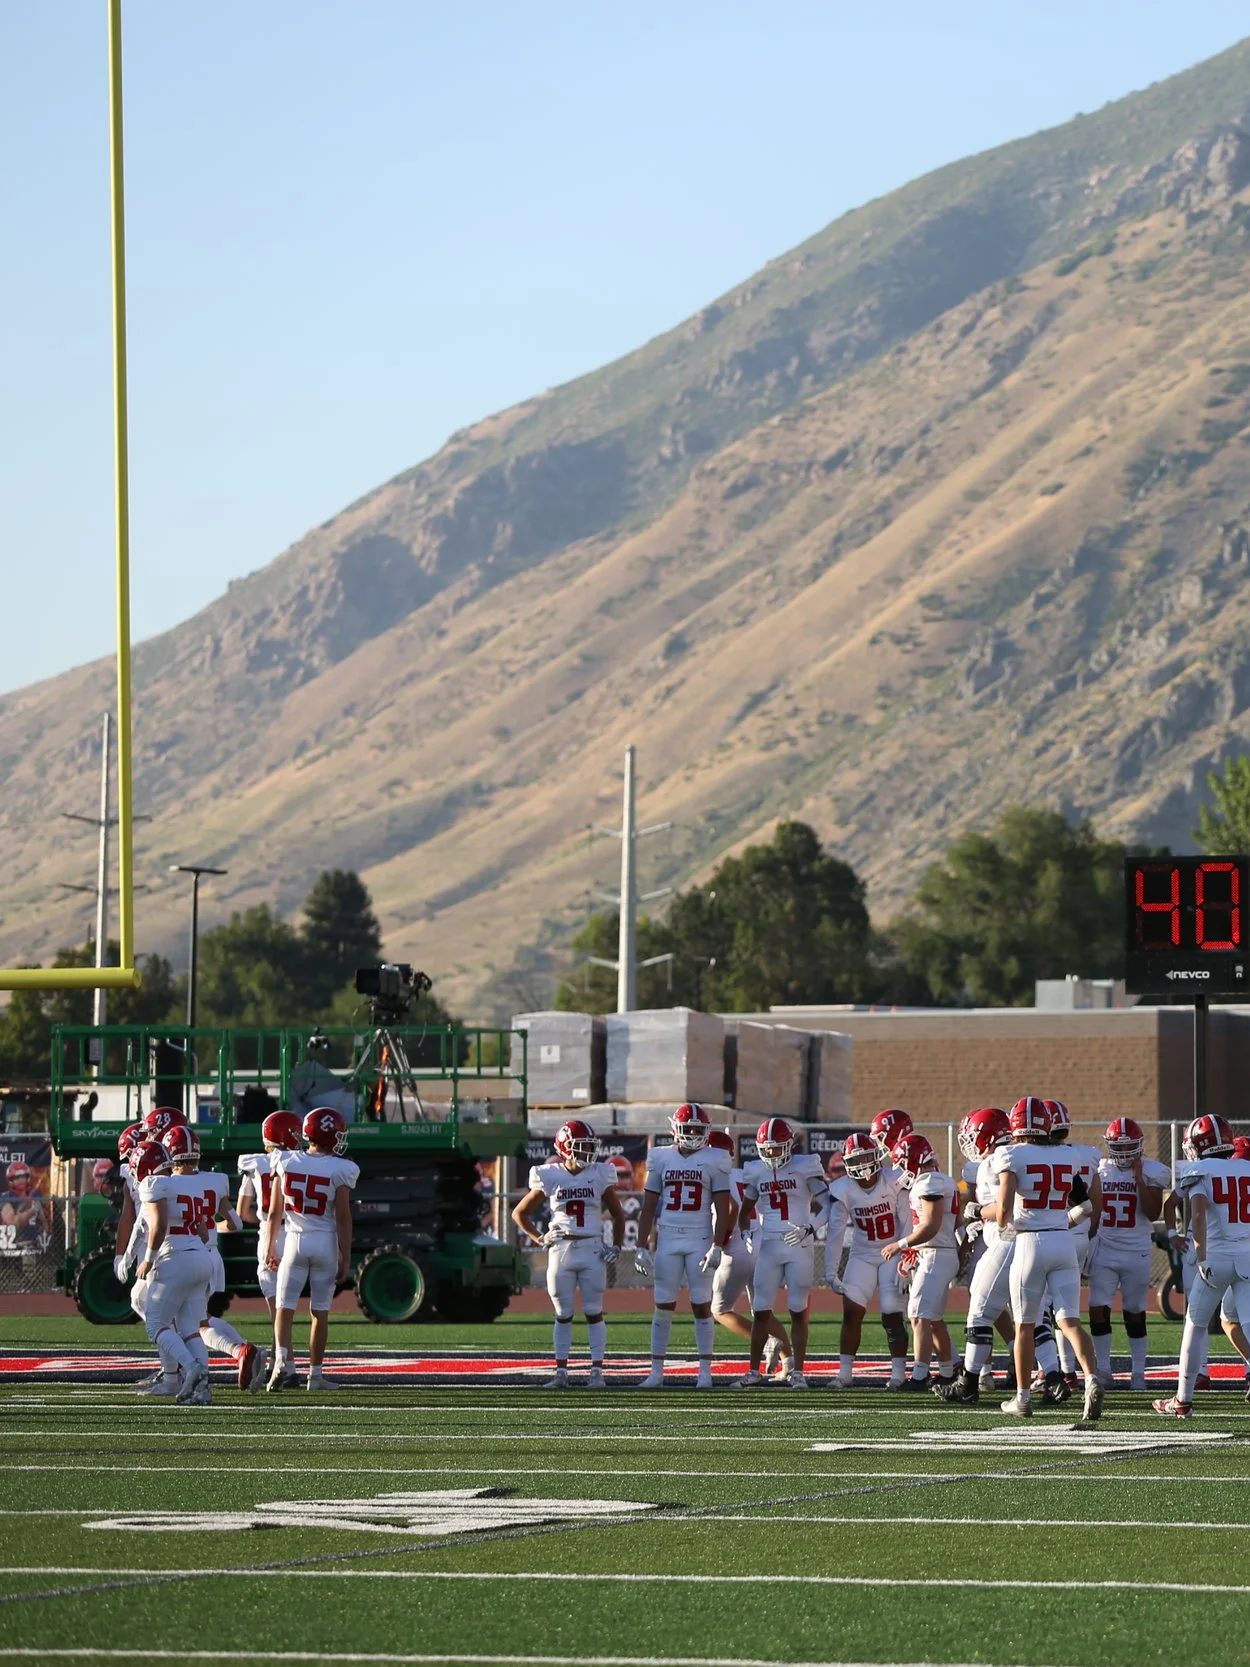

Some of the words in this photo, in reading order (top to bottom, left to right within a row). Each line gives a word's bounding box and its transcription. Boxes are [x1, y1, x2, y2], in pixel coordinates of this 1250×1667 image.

[1135, 863, 1240, 950] 40
[1173, 970, 1210, 979] NEVCO
[72, 1126, 120, 1138] SKYJACK
[665, 1170, 702, 1180] CRIMSON
[1023, 1164, 1072, 1210] 35
[1103, 1181, 1137, 1193] CRIMSON
[284, 1172, 331, 1217] 55
[557, 1188, 594, 1200] CRIMSON
[665, 1181, 703, 1211] 33
[769, 1191, 789, 1221] 4
[566, 1199, 585, 1227] 9
[855, 1202, 891, 1217] CRIMSON
[1102, 1194, 1137, 1228] 53
[855, 1213, 895, 1241] 40
